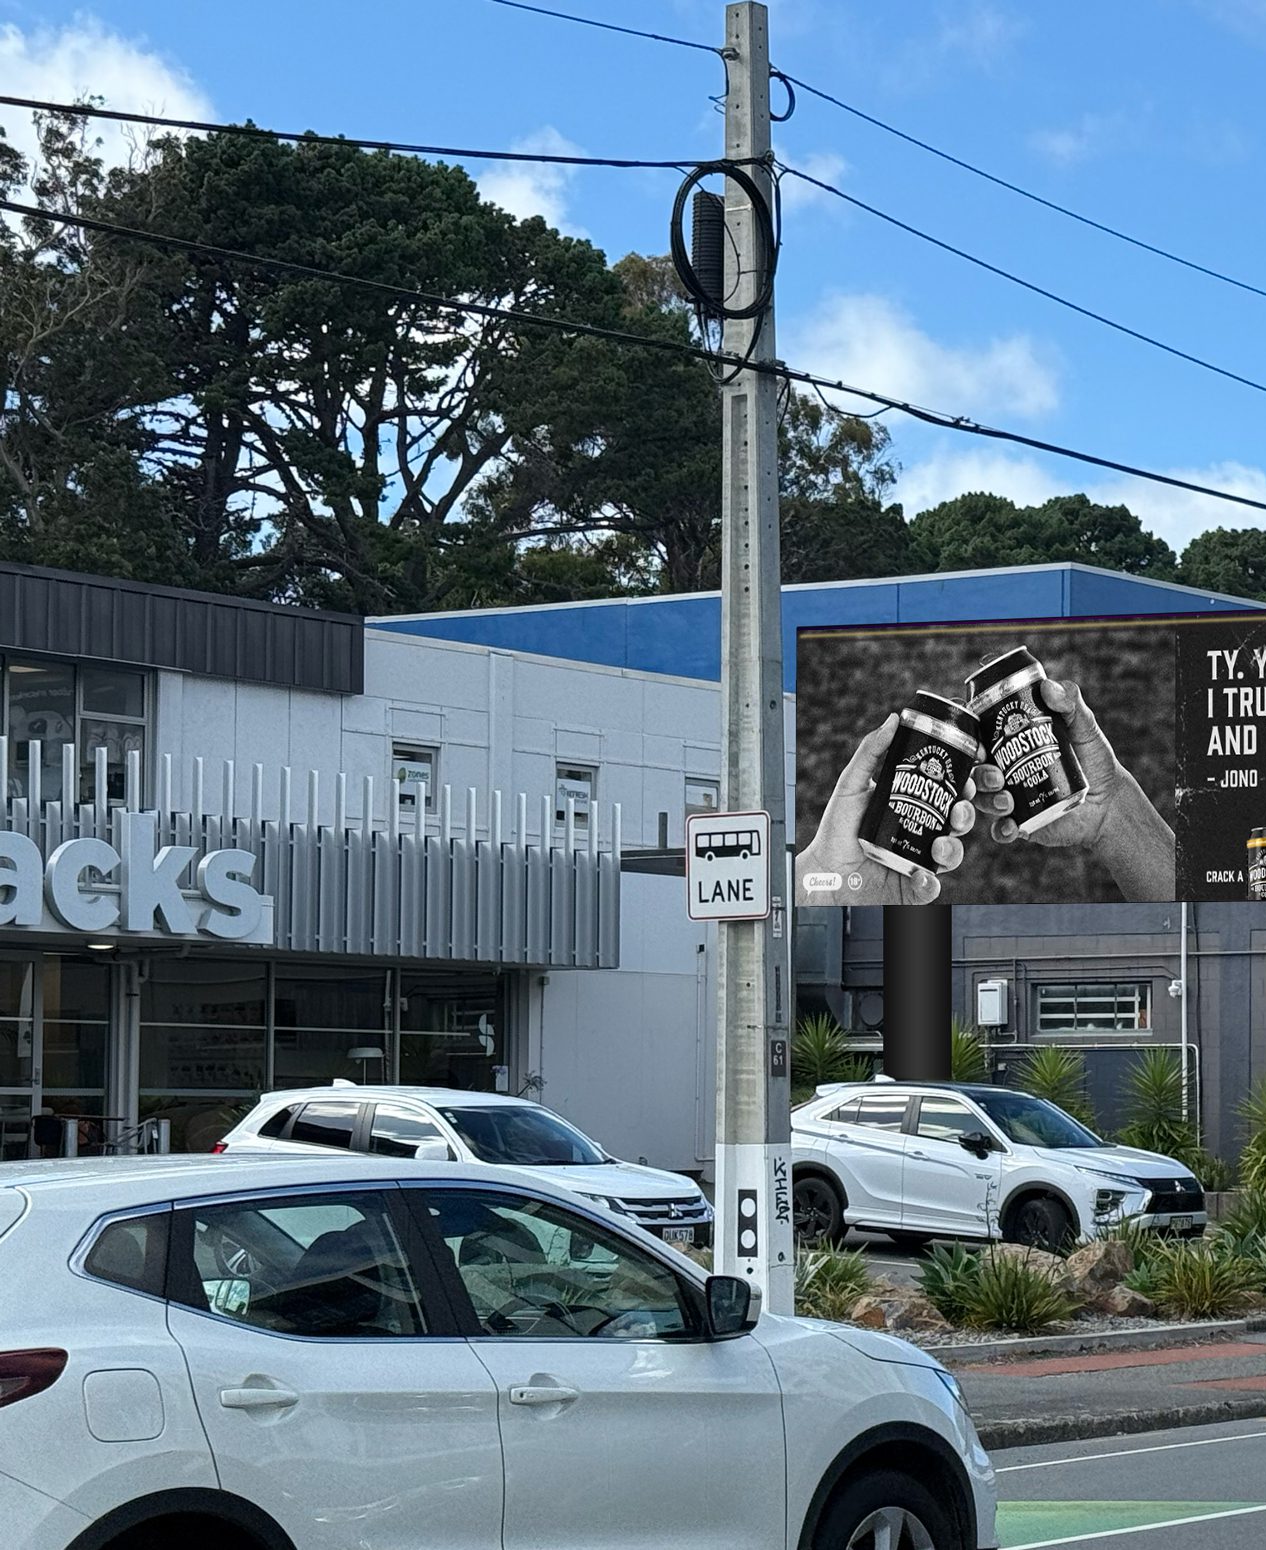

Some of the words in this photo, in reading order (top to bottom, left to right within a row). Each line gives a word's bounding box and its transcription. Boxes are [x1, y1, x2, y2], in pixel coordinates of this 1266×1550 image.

[1207, 649, 1244, 680] TY.
[1207, 687, 1214, 718] I
[994, 722, 1059, 771] WOODSTOCK
[1207, 724, 1257, 756] AND
[1012, 751, 1055, 785] BOURBON
[1027, 769, 1049, 788] COLA
[1220, 769, 1258, 788] JONO
[891, 771, 954, 818] WOODSTOCK
[894, 801, 938, 831] BOURBON
[903, 817, 923, 836] COLA
[0, 812, 262, 938] acks
[1206, 870, 1235, 883] CRACK
[1237, 870, 1244, 882] A
[698, 878, 754, 903] LANE
[773, 1055, 784, 1066] 61
[775, 1043, 782, 1054] C
